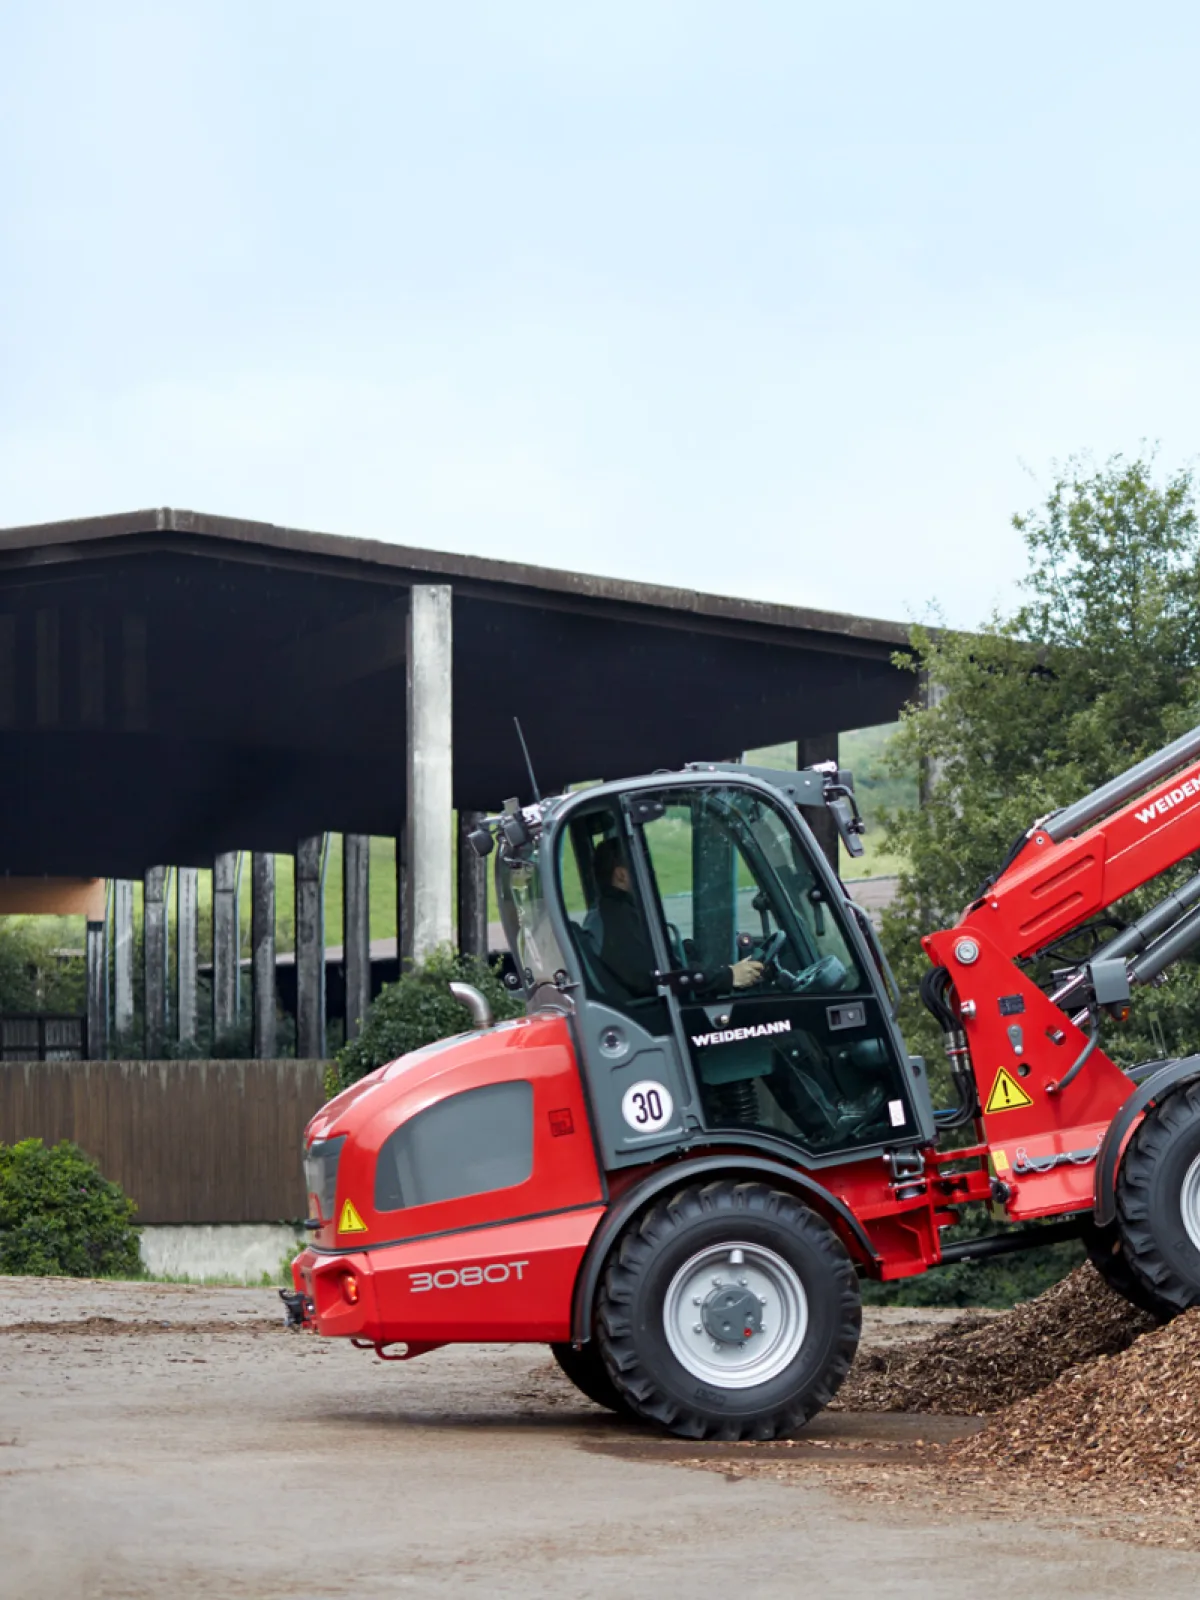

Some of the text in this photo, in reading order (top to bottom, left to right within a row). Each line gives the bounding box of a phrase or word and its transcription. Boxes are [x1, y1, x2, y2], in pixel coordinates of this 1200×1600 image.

[691, 1019, 791, 1047] WEIDEMANN
[632, 1090, 663, 1124] 30
[408, 1260, 529, 1293] 3080T
